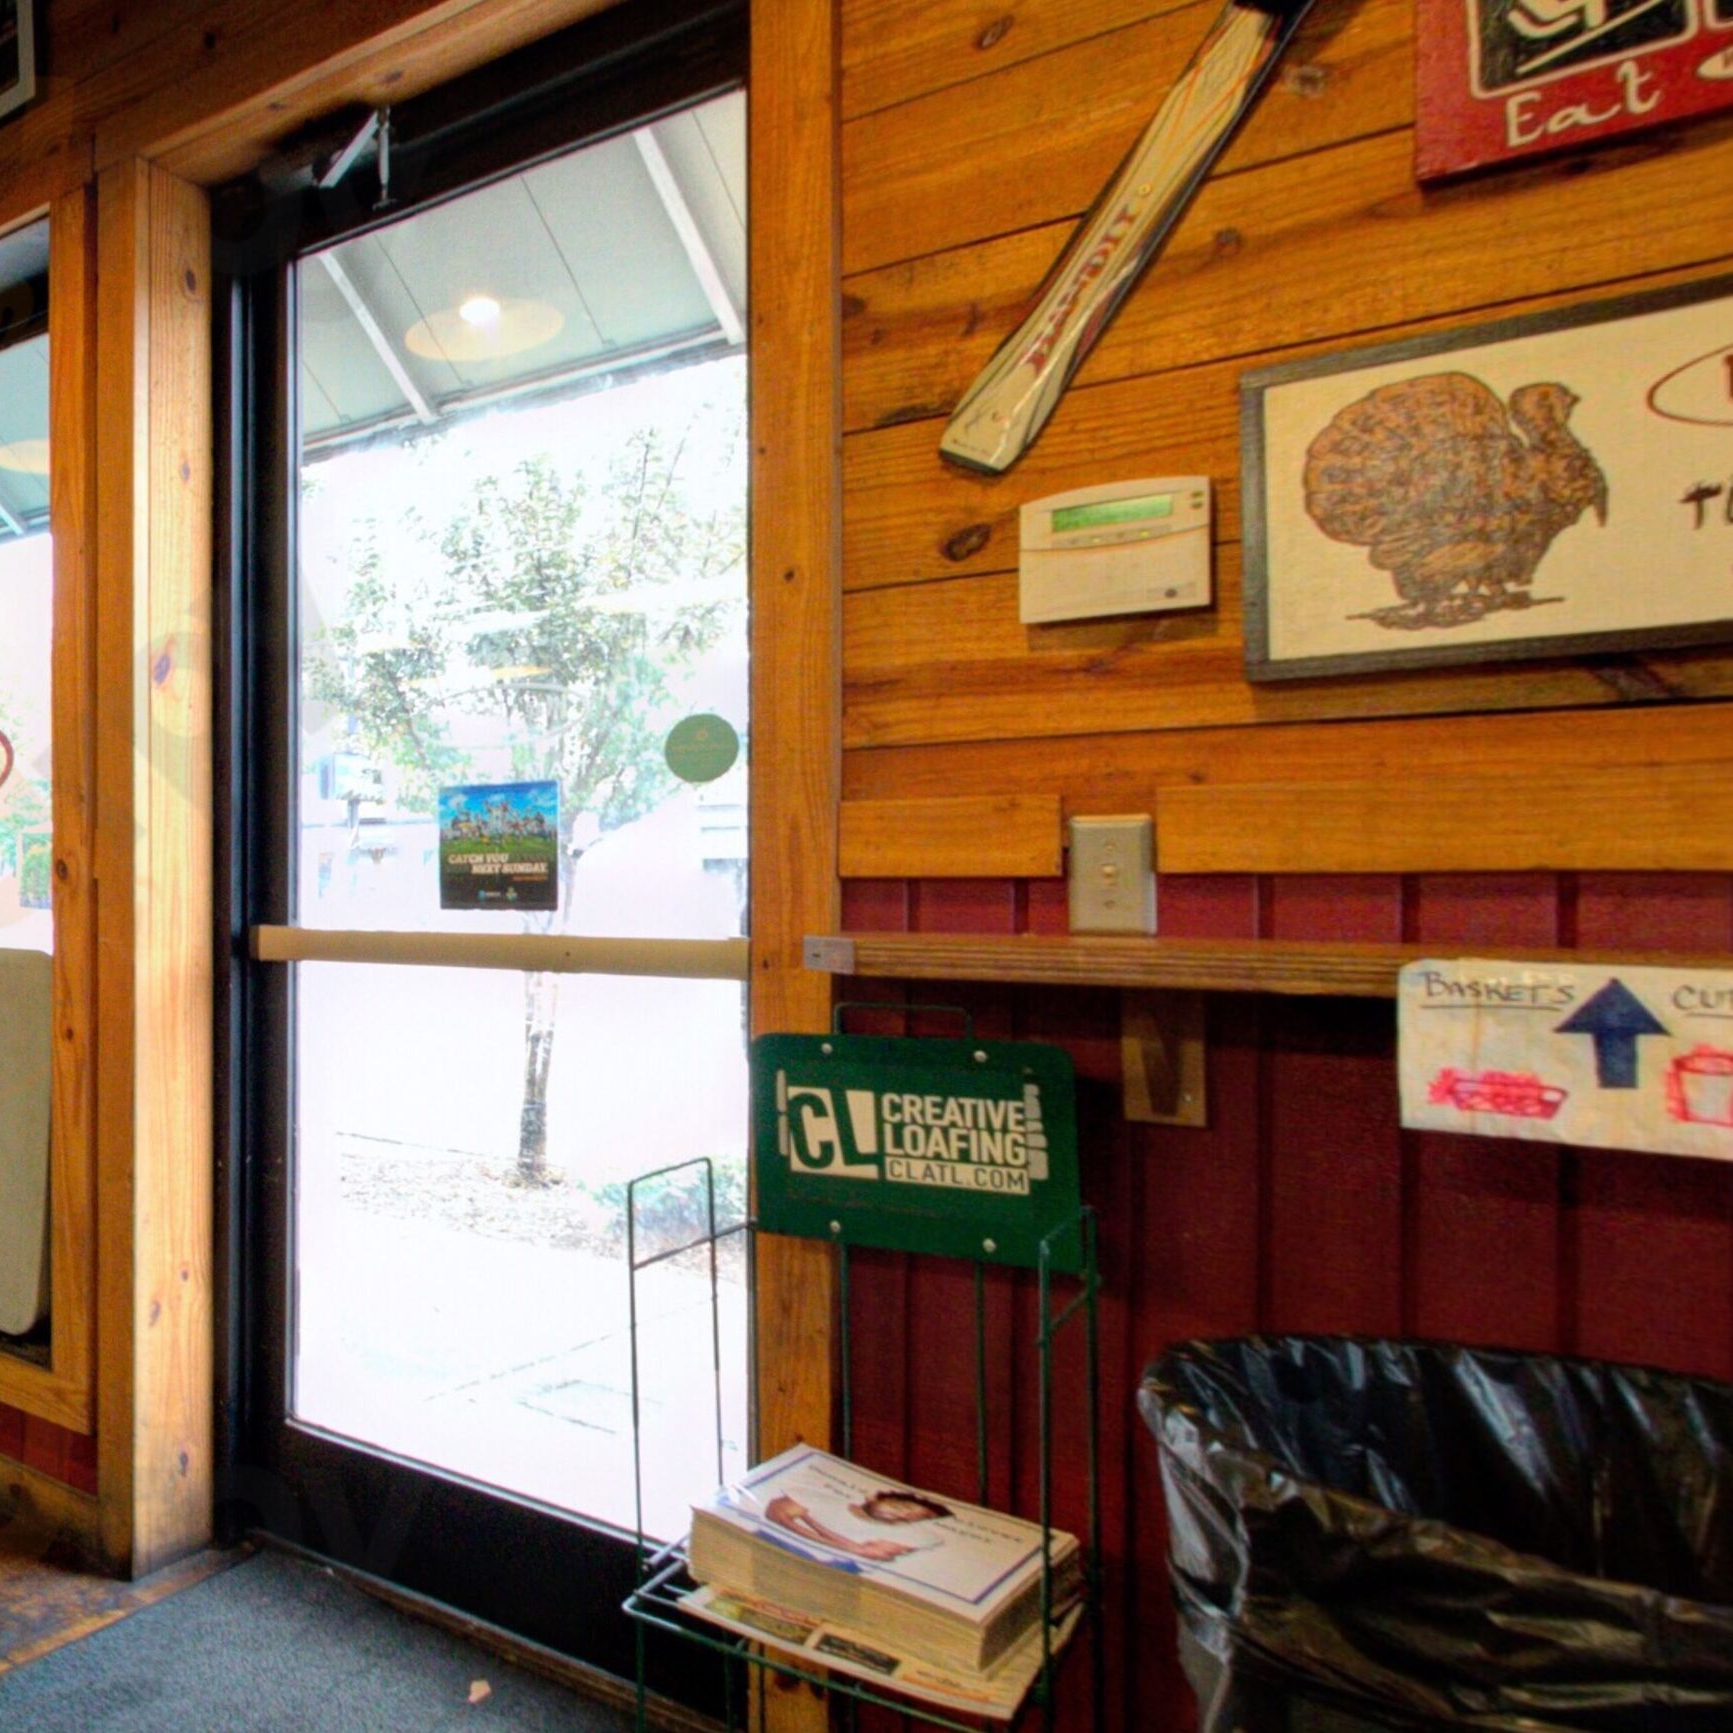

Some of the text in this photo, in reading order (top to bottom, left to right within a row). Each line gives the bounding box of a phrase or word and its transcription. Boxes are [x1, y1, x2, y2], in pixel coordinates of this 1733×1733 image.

[1506, 60, 1661, 147] Eat
[1679, 478, 1733, 529] T
[1424, 971, 1733, 1009] BASKETS CU
[881, 1092, 1026, 1132] CREATIVE
[883, 1122, 1027, 1166] LOAFING
[889, 1158, 1028, 1193] CLATL.COM
